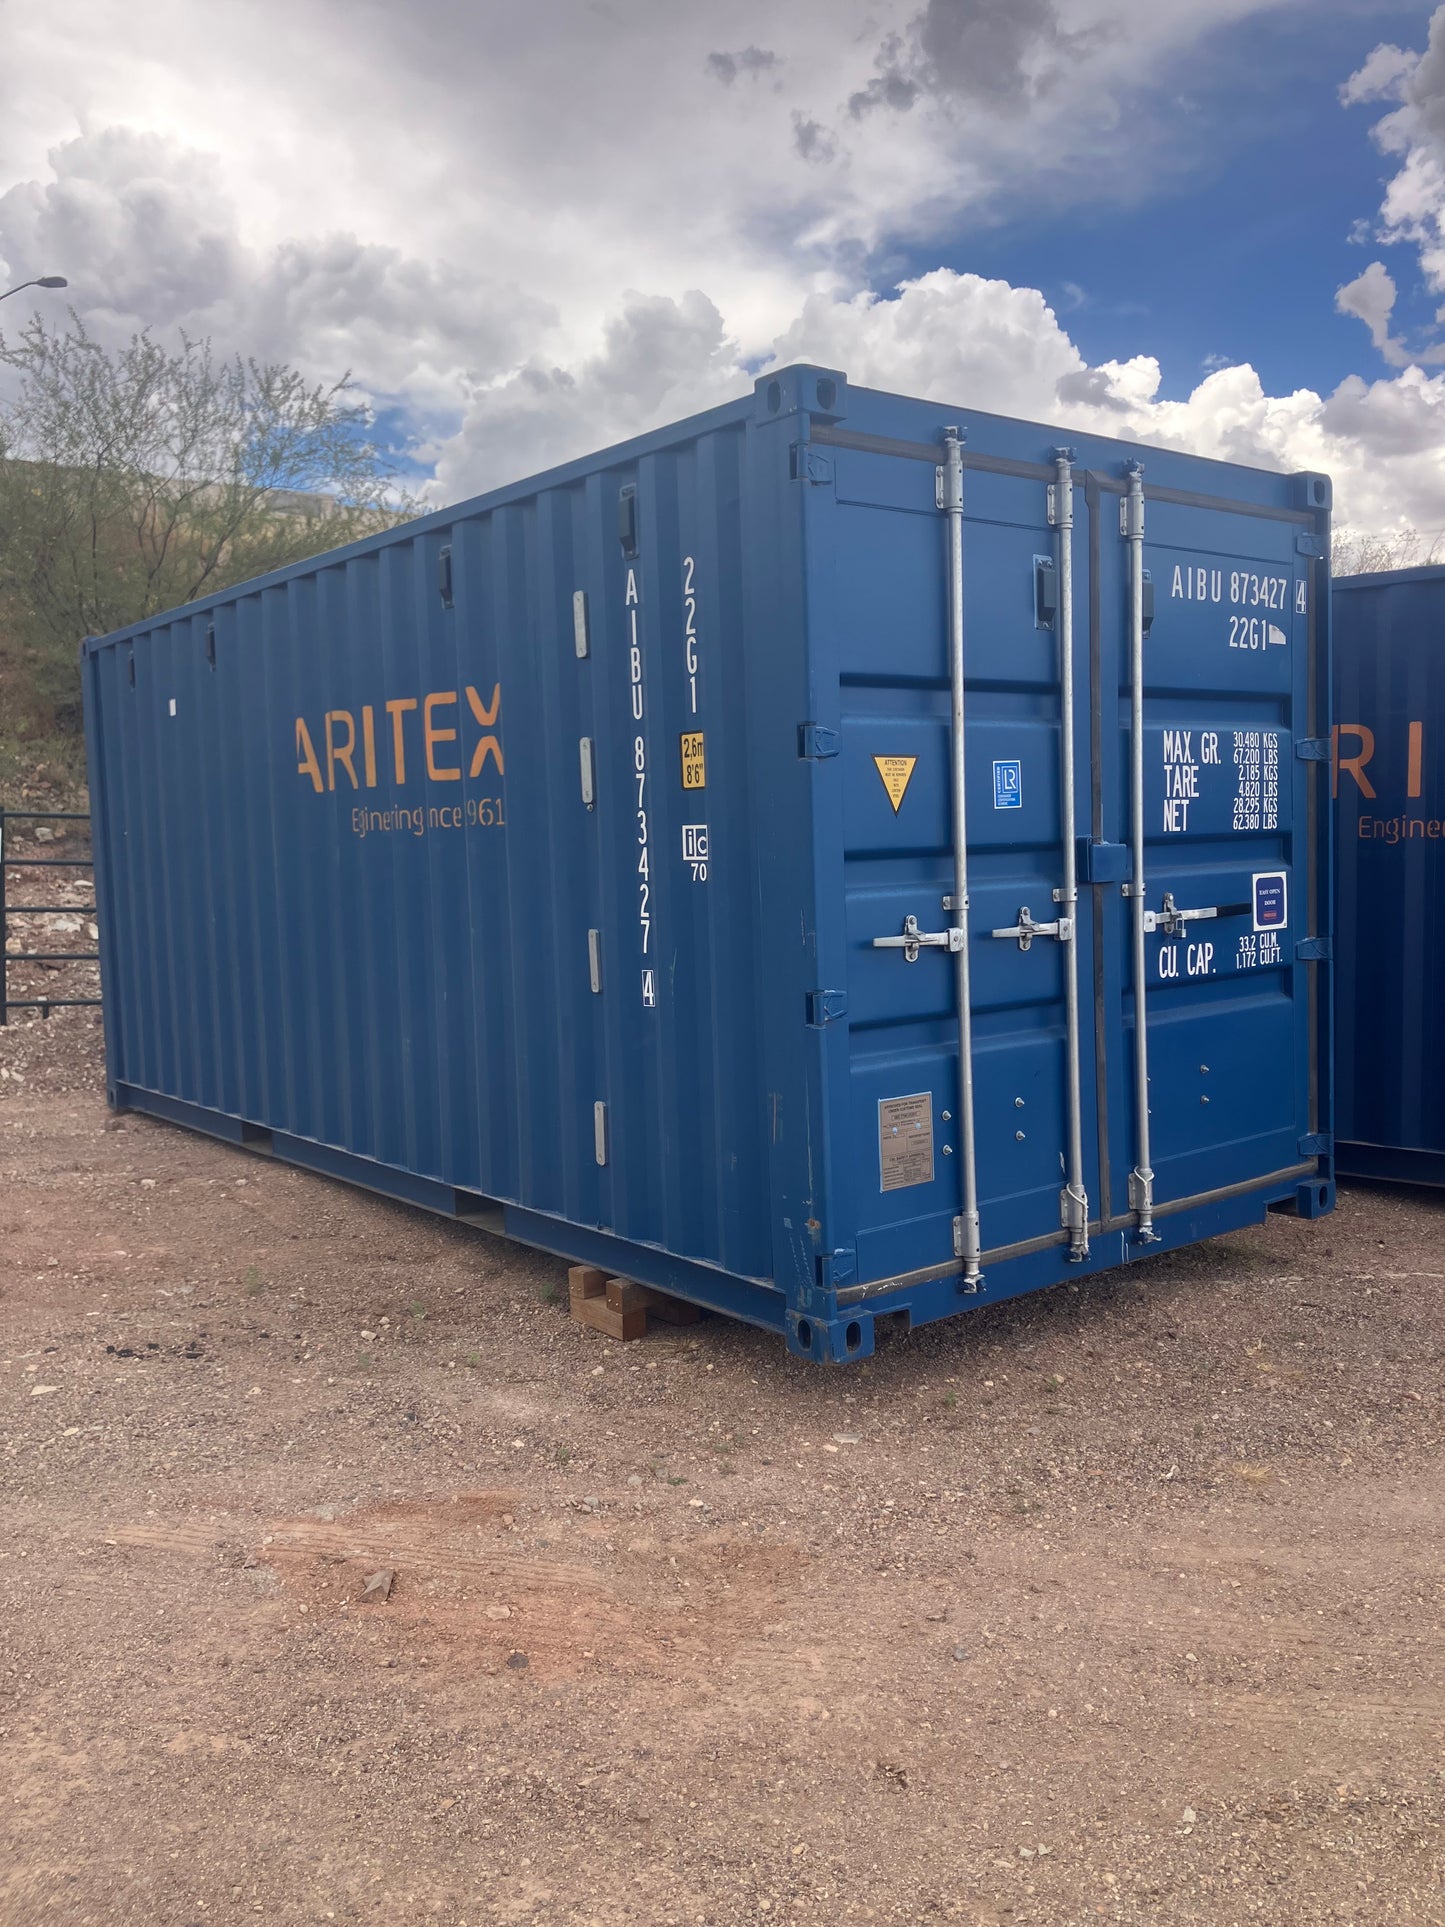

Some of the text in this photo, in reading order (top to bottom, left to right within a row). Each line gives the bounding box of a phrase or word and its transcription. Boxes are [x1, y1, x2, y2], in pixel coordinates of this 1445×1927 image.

[1171, 565, 1306, 612] AIBU 873427 4
[684, 556, 698, 713] 22G1
[1229, 616, 1266, 650] 22G1
[295, 682, 504, 793] ARITEX
[1163, 730, 1278, 764] MAX. GR. 30.480 KGS
[1233, 749, 1278, 765] 67.200 LBS
[625, 569, 654, 1005] AIBU 873427 4
[1004, 769, 1017, 789] LR
[1163, 765, 1278, 798] TARE 2.185 KGS
[1238, 781, 1278, 797] 4.820 LBS
[1163, 797, 1278, 832] NET 28.295 KGS
[1262, 814, 1278, 829] LBS
[691, 863, 707, 881] 70
[1159, 945, 1179, 979] CU.
[1187, 942, 1216, 976] CAP.
[1239, 935, 1256, 952] 33.2
